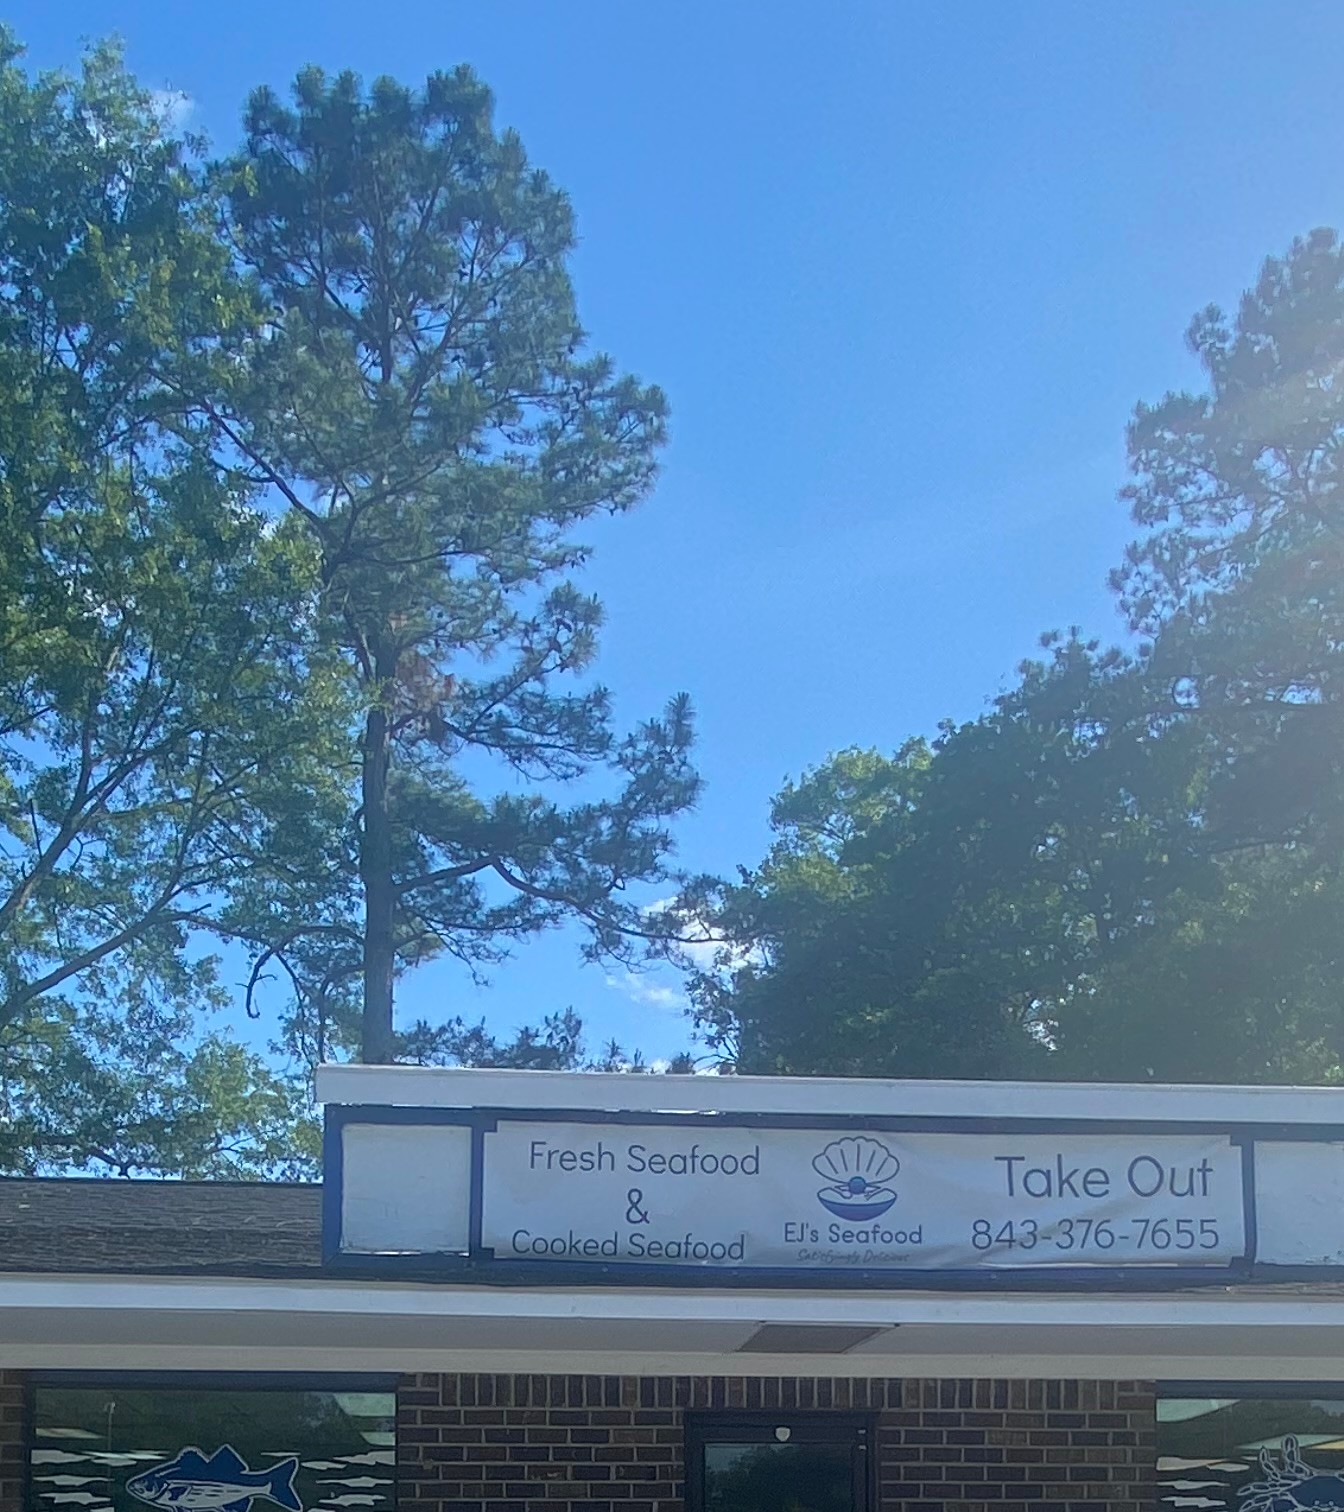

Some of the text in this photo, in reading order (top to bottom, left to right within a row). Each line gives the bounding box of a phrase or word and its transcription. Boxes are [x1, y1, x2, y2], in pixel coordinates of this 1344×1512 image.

[529, 1140, 760, 1175] Fresh Seafood
[994, 1153, 1214, 1198] Take Out
[625, 1187, 650, 1225] &
[511, 1229, 746, 1260] Cooked Seafood
[784, 1222, 922, 1244] EJ's Seafood
[971, 1218, 1219, 1250] 843-376-7655
